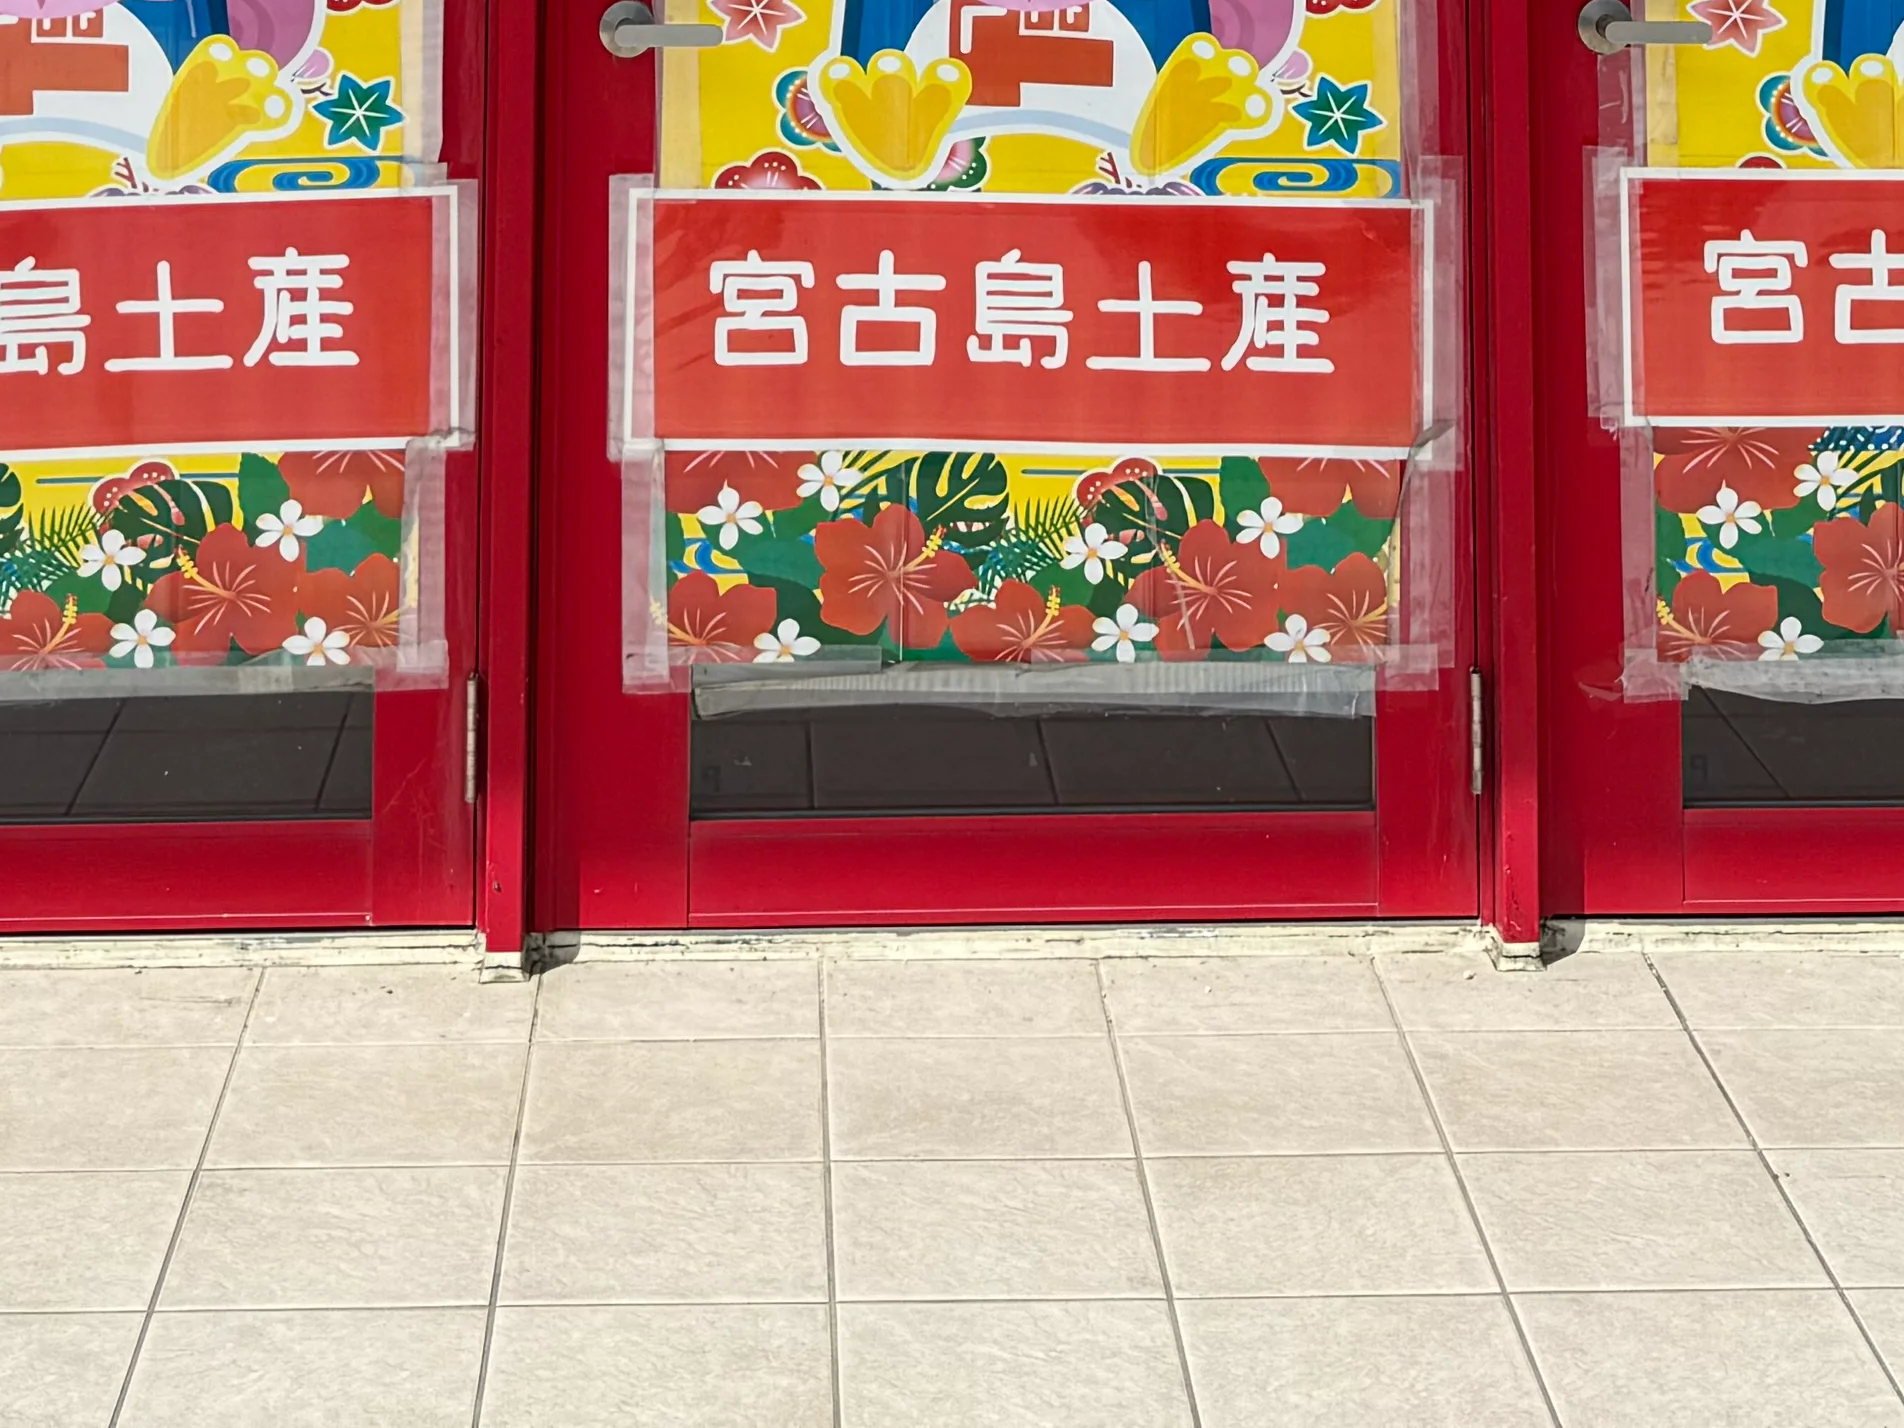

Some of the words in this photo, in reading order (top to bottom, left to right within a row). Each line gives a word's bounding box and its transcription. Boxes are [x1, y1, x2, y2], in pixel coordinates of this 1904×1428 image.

[708, 248, 1335, 374] 宮古島土産
